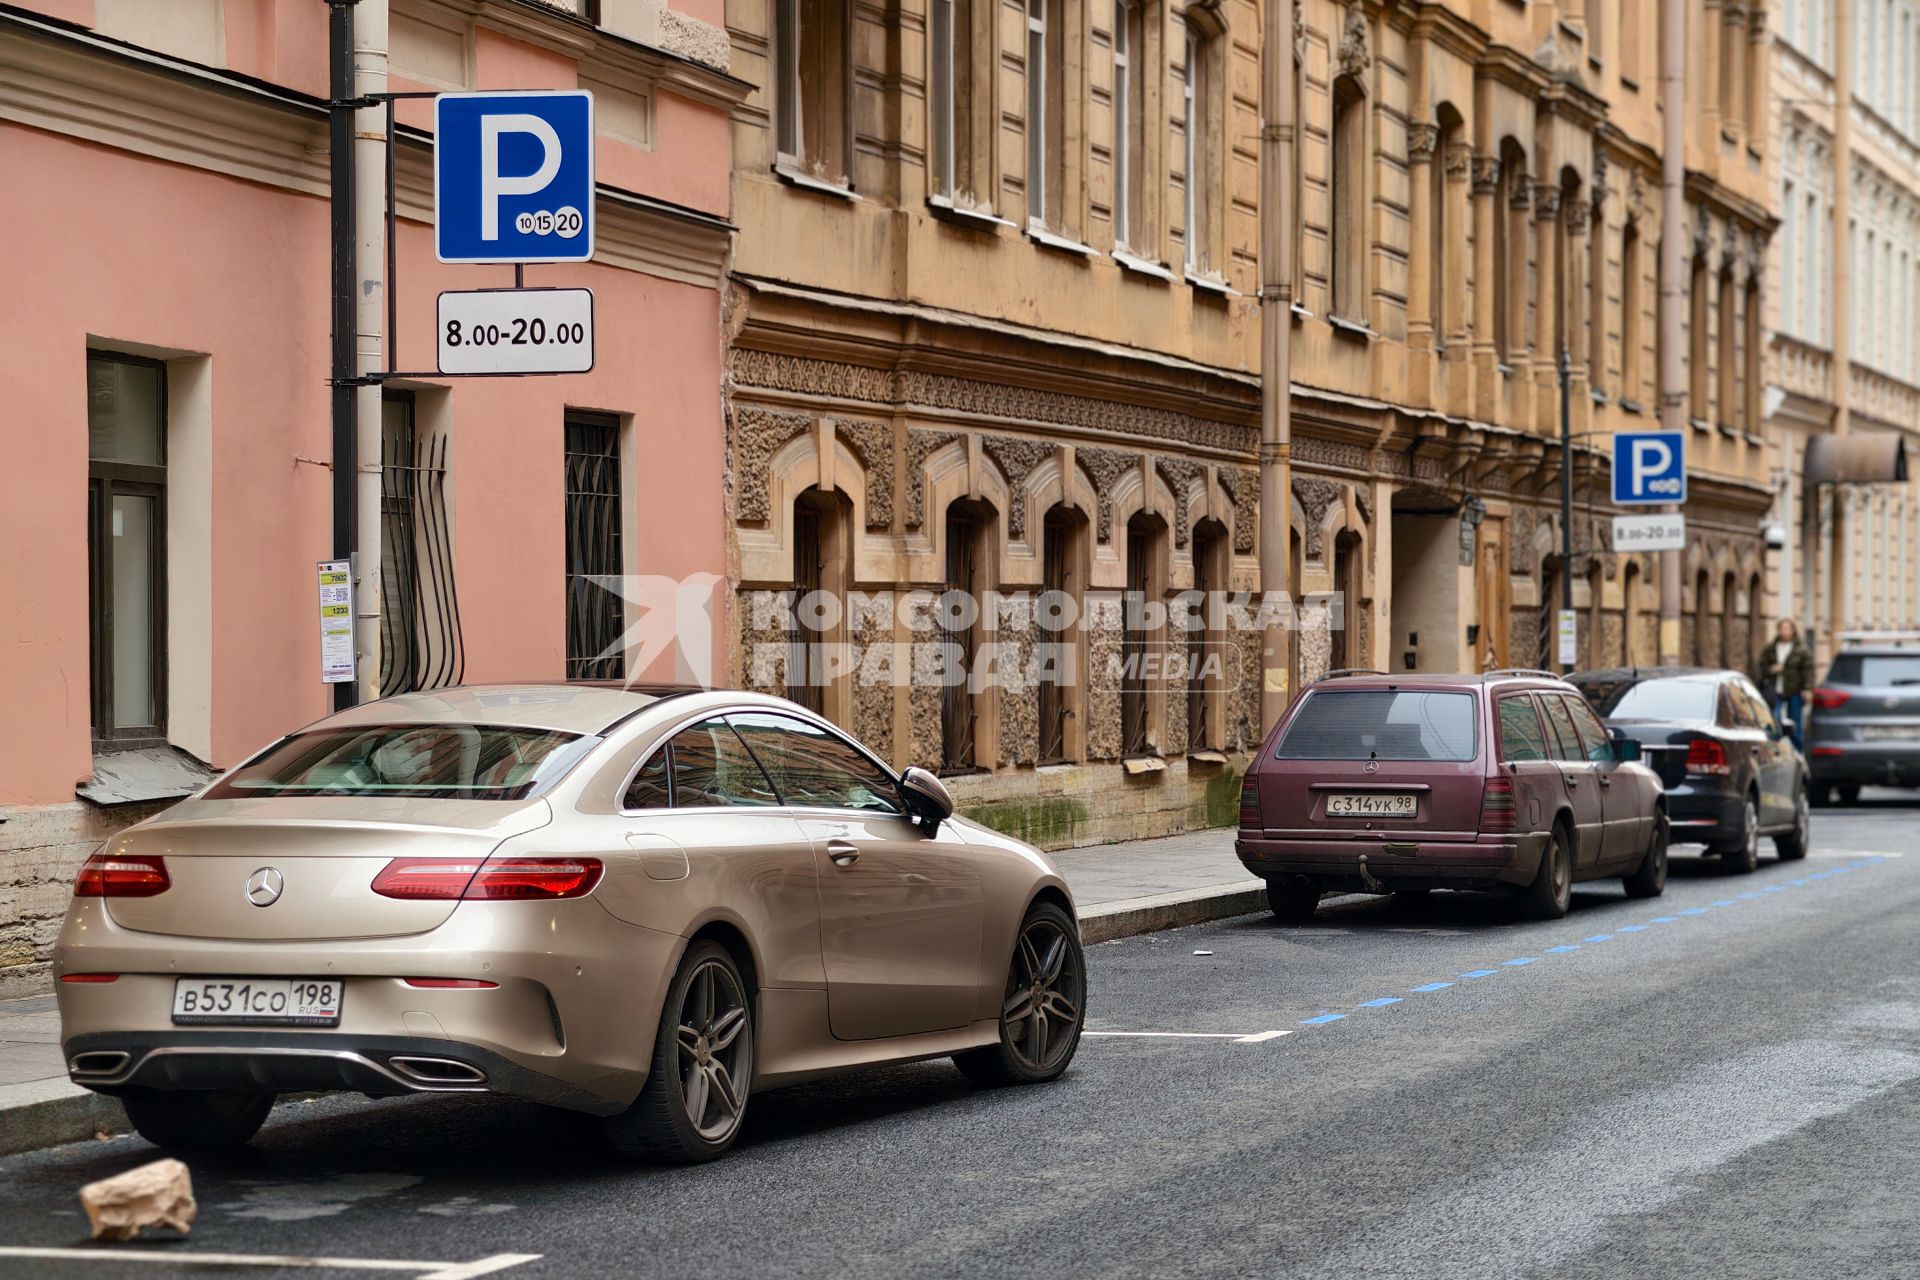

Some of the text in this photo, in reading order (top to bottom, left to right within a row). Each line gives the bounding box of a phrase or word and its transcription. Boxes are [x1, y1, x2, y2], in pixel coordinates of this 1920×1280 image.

[481, 113, 562, 241] P
[520, 213, 580, 231] 10 15 20
[446, 317, 584, 347] 8.00-20.00
[1632, 439, 1672, 496] P
[332, 606, 349, 614] 1233
[1396, 797, 1412, 809] 98
[294, 984, 333, 1006] 198
[298, 1007, 319, 1015] RUS
